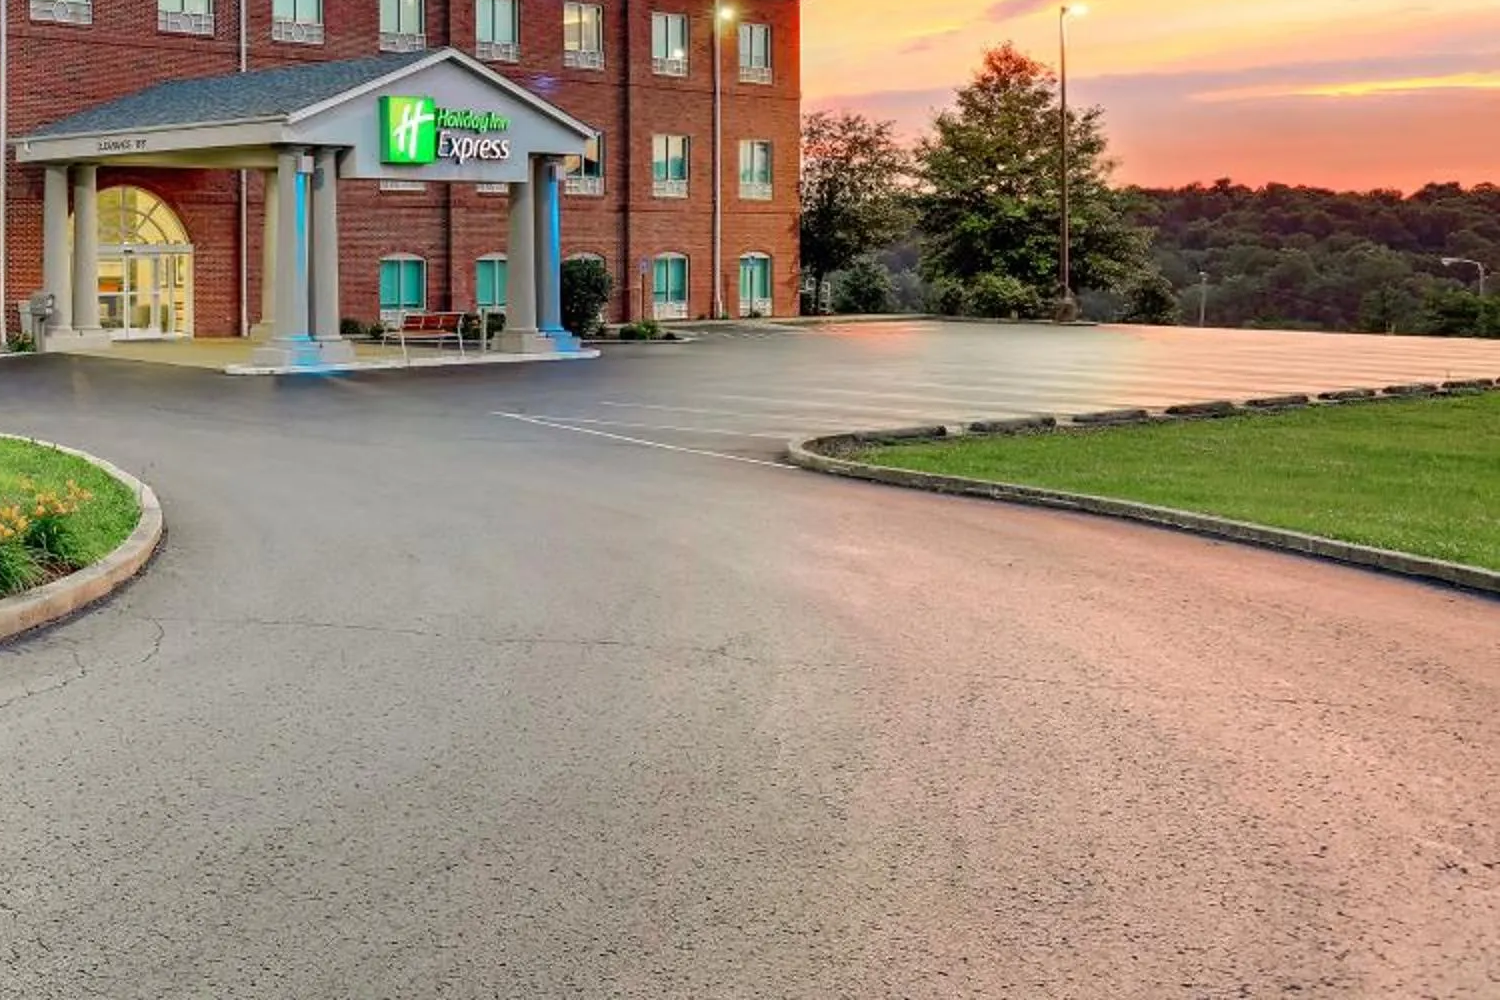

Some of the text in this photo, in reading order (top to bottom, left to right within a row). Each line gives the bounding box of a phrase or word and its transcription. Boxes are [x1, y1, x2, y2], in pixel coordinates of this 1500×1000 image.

[437, 109, 510, 132] Holiday Inn
[438, 131, 510, 164] Express
